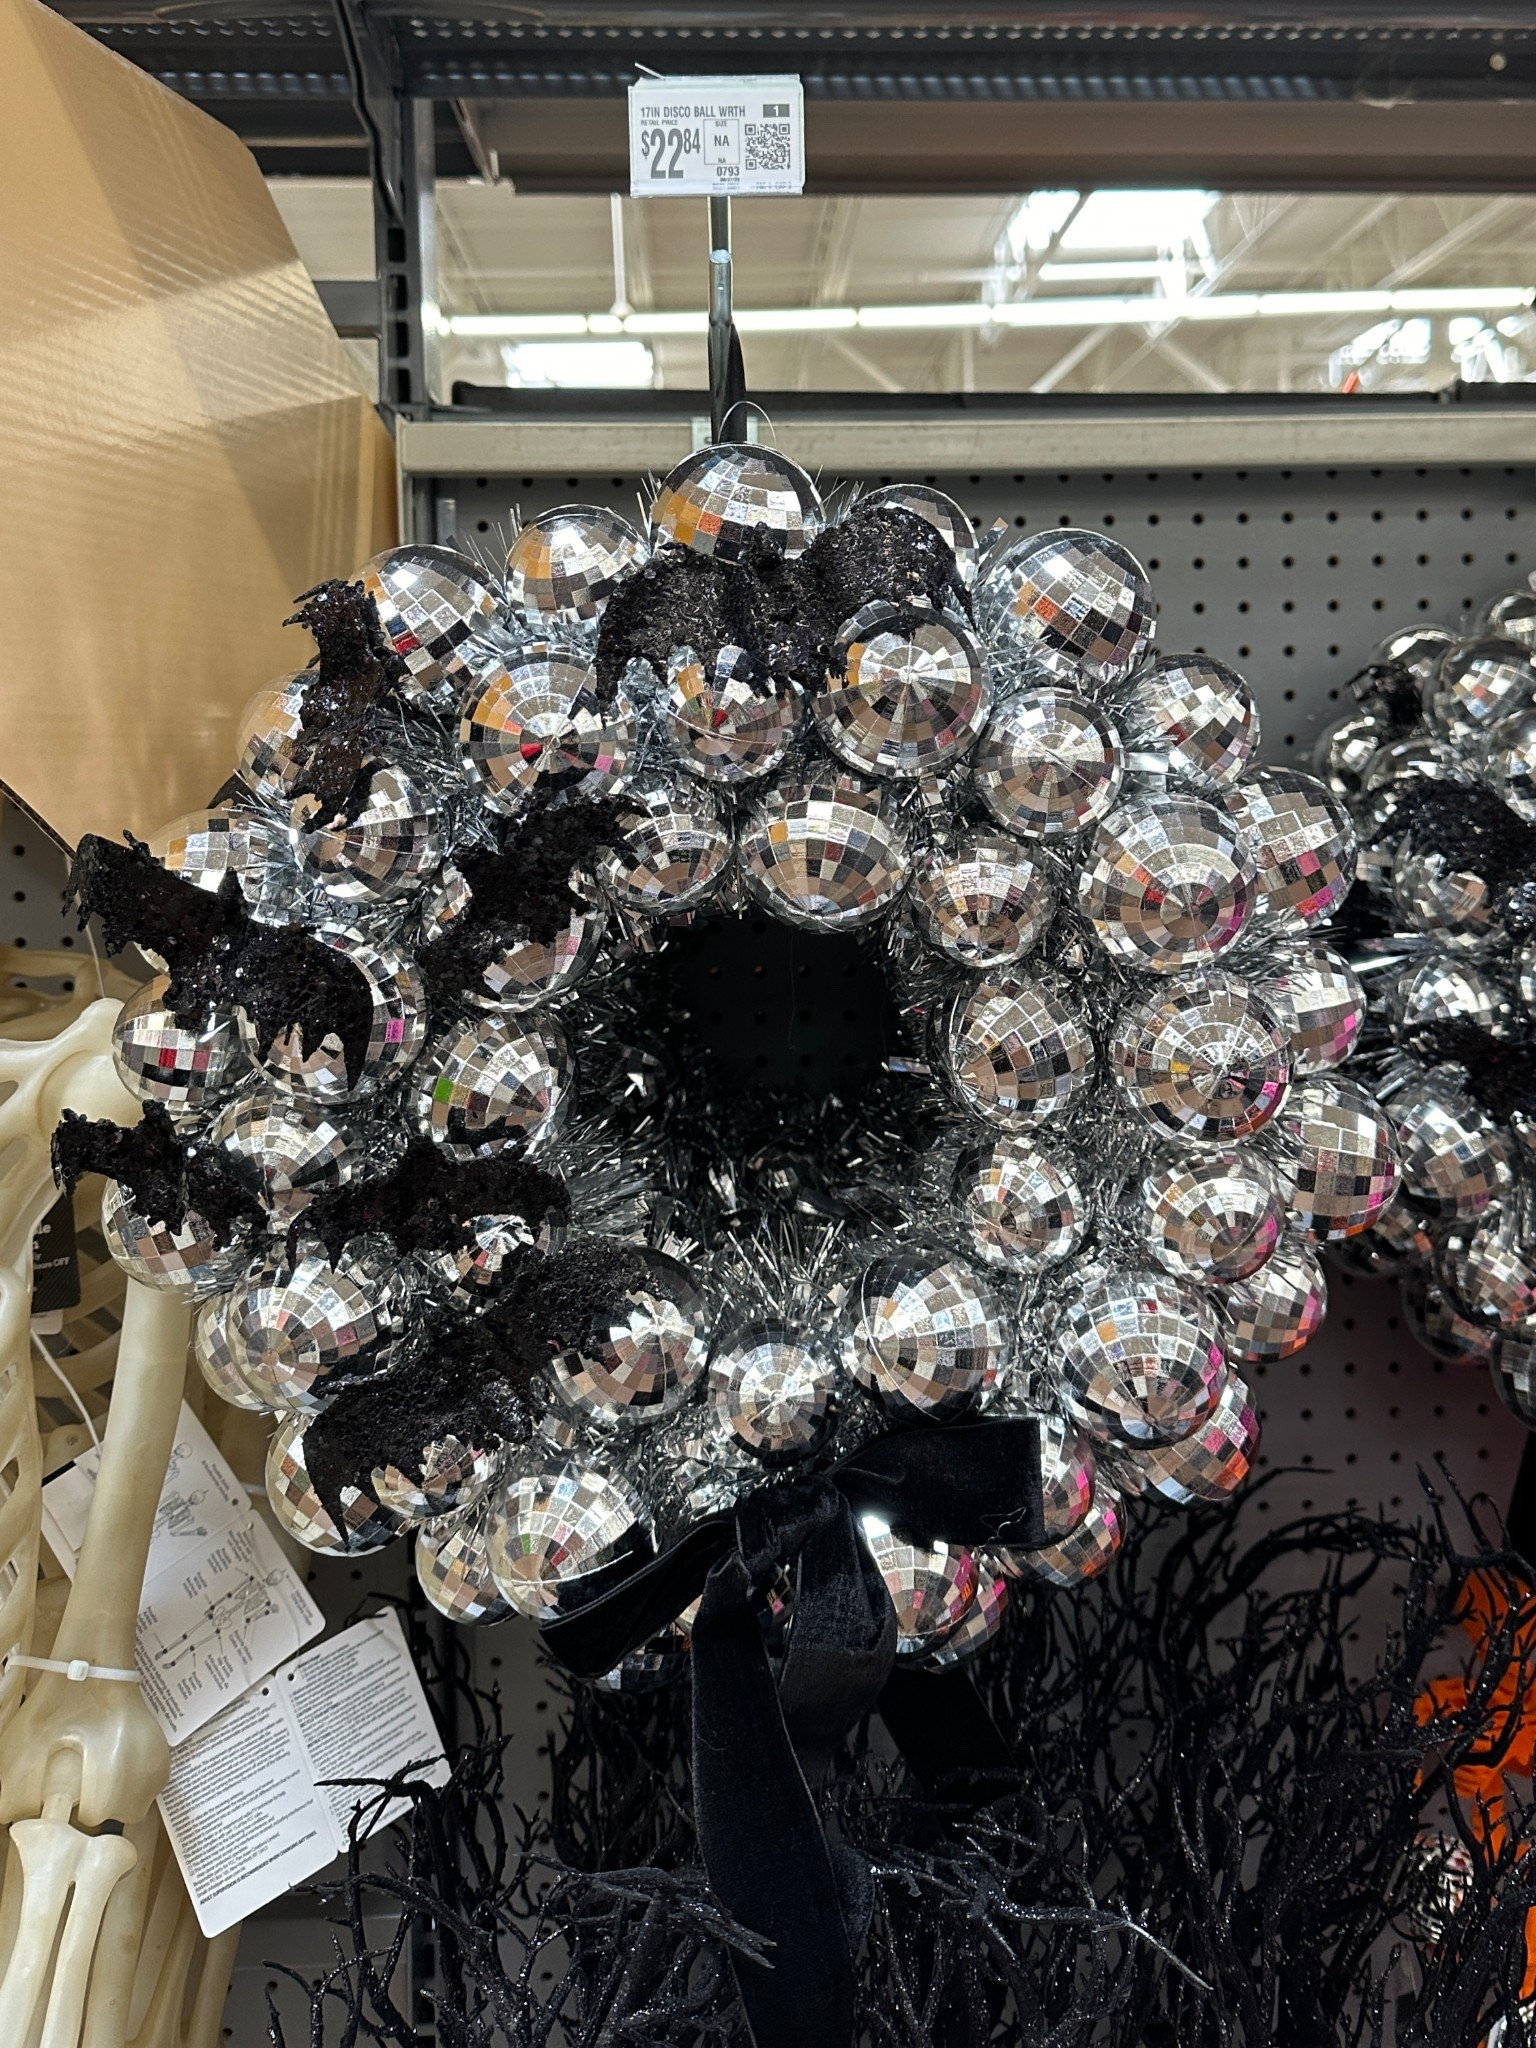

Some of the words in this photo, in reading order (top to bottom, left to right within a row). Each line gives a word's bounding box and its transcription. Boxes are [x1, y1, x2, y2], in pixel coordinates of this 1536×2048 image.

[640, 106, 660, 118] 17IN
[663, 106, 691, 118] DISCO
[694, 106, 716, 118] BALL
[719, 105, 746, 117] WRTH
[714, 135, 730, 147] NA
[716, 166, 740, 177] 0793
